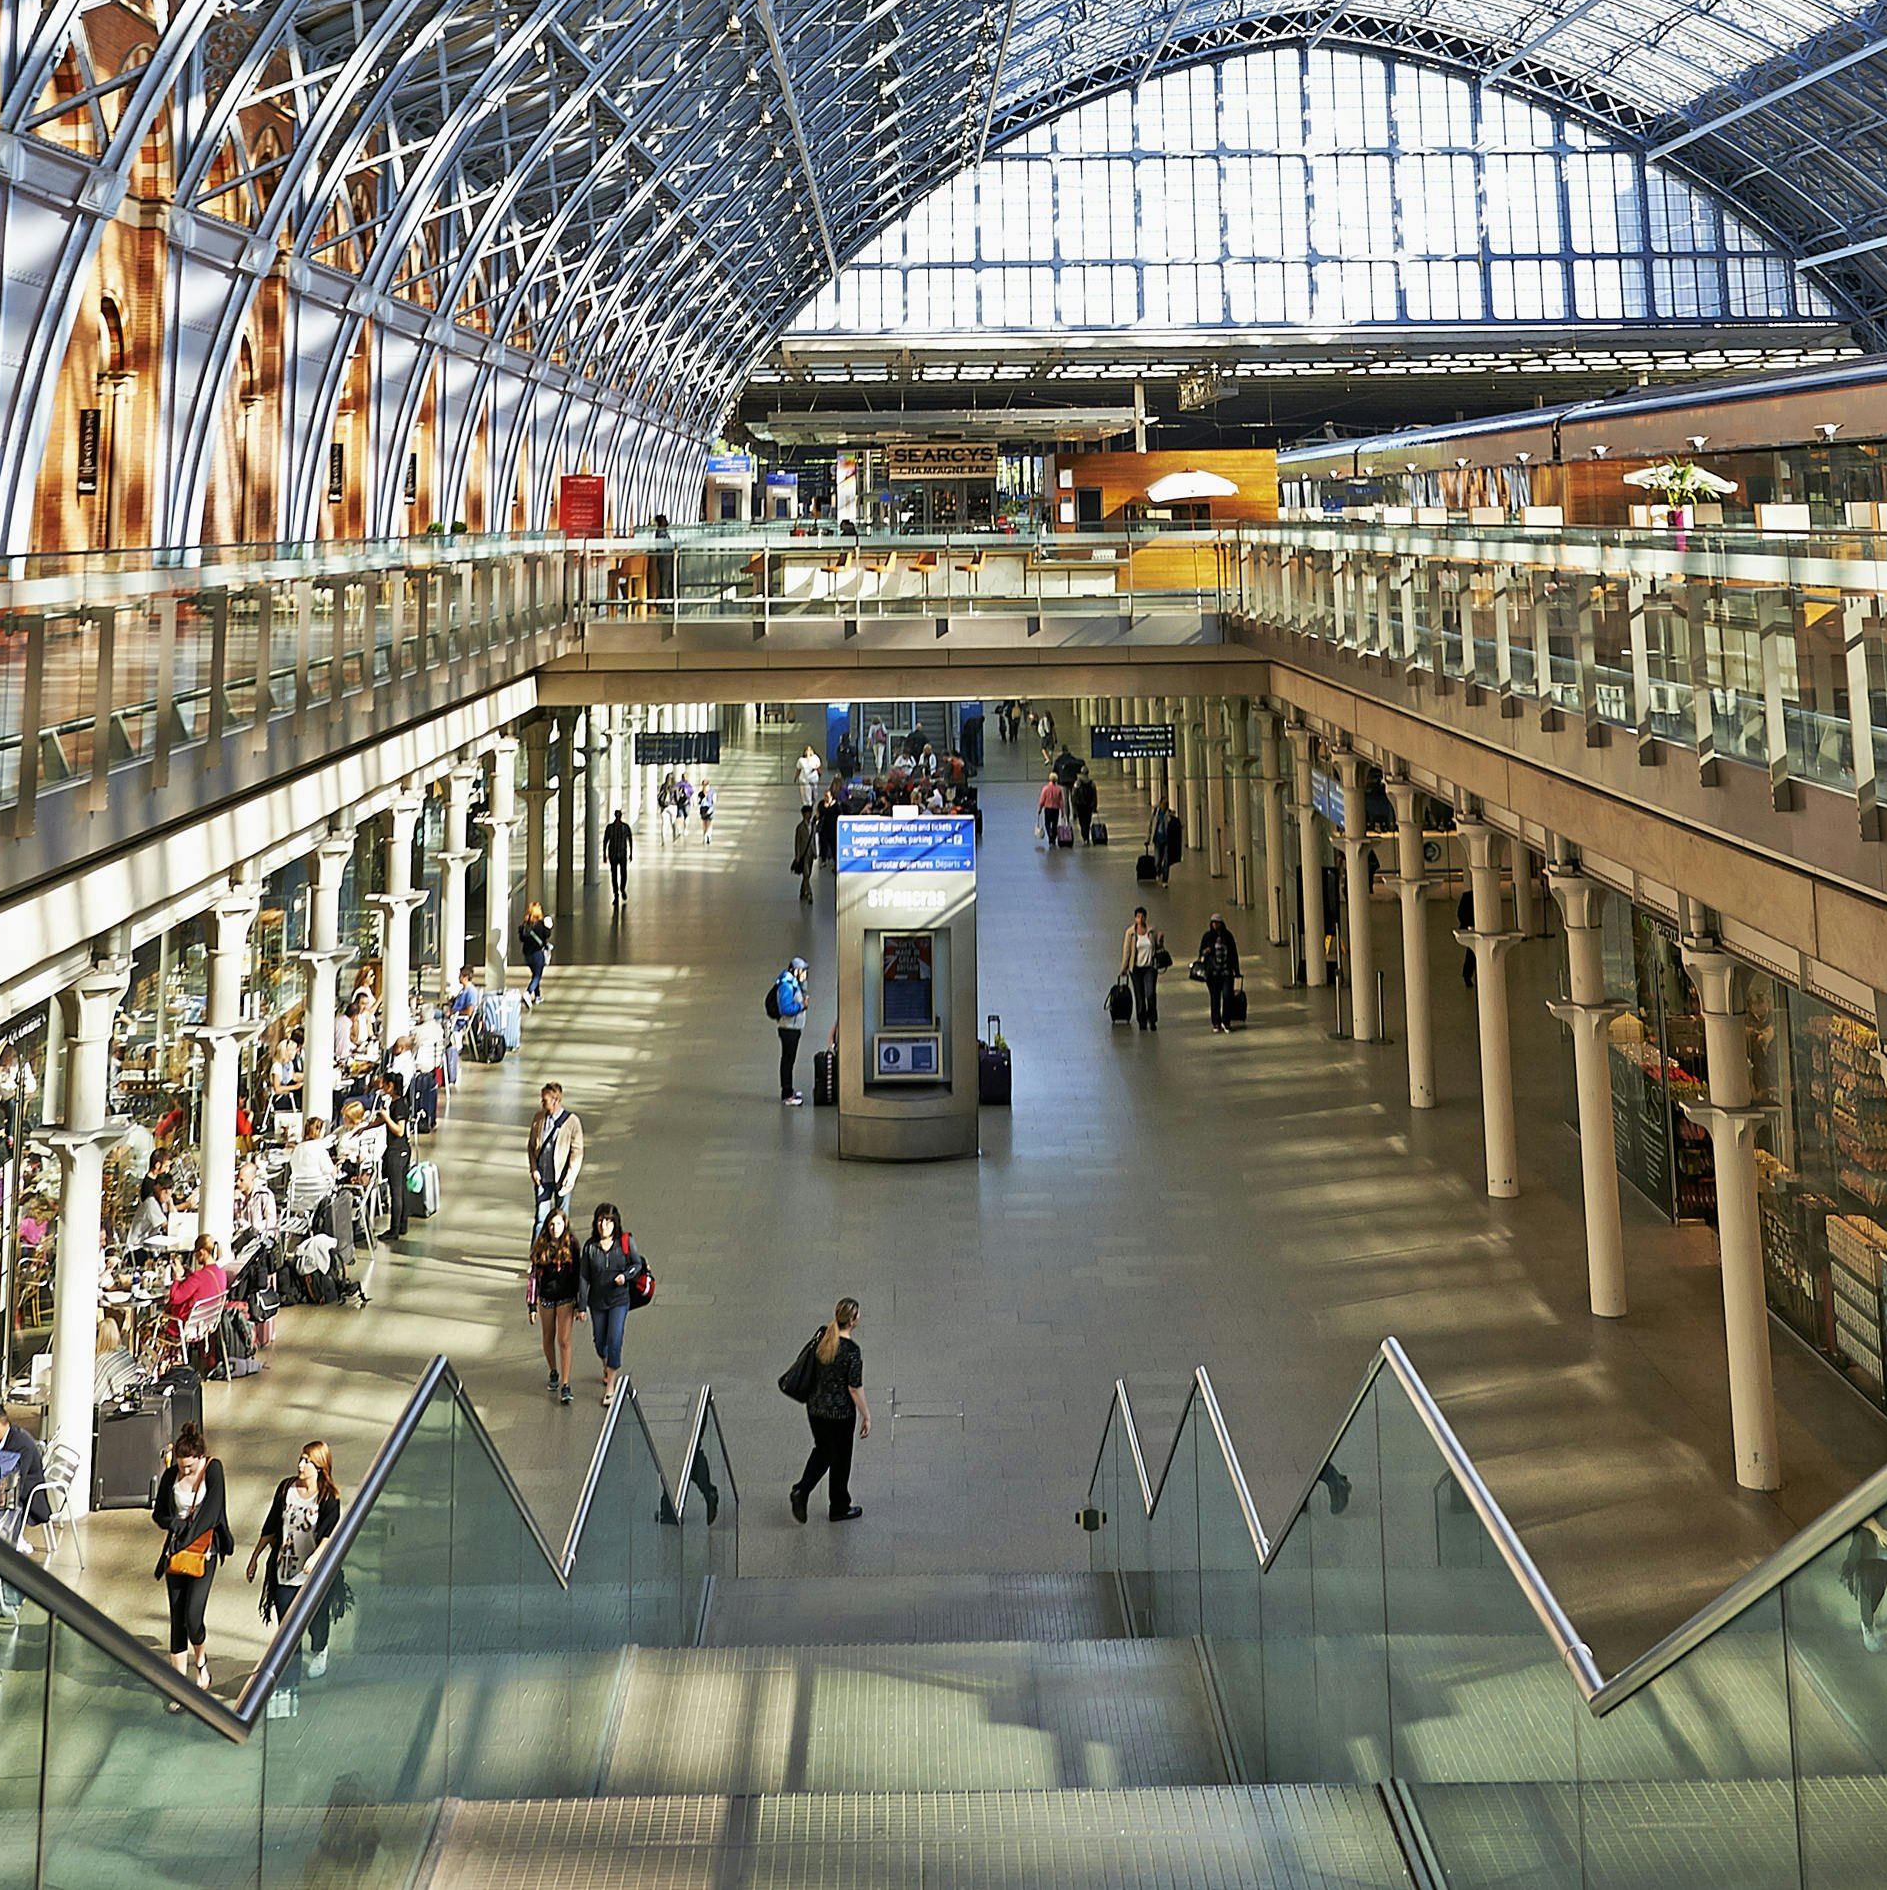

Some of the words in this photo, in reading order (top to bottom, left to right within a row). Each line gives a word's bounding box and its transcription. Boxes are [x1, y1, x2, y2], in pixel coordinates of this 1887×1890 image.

[894, 447, 993, 463] SEARCYS
[899, 466, 967, 475] CHAMPAGNE
[969, 465, 987, 474] BAR
[851, 822, 879, 832] National
[880, 822, 891, 832] Rail
[892, 822, 918, 832] services
[919, 822, 930, 832] and
[931, 822, 952, 832] tickets
[908, 835, 932, 846] parking
[852, 848, 868, 857] Taxis
[872, 860, 898, 869] Eurostar
[899, 860, 933, 870] departures
